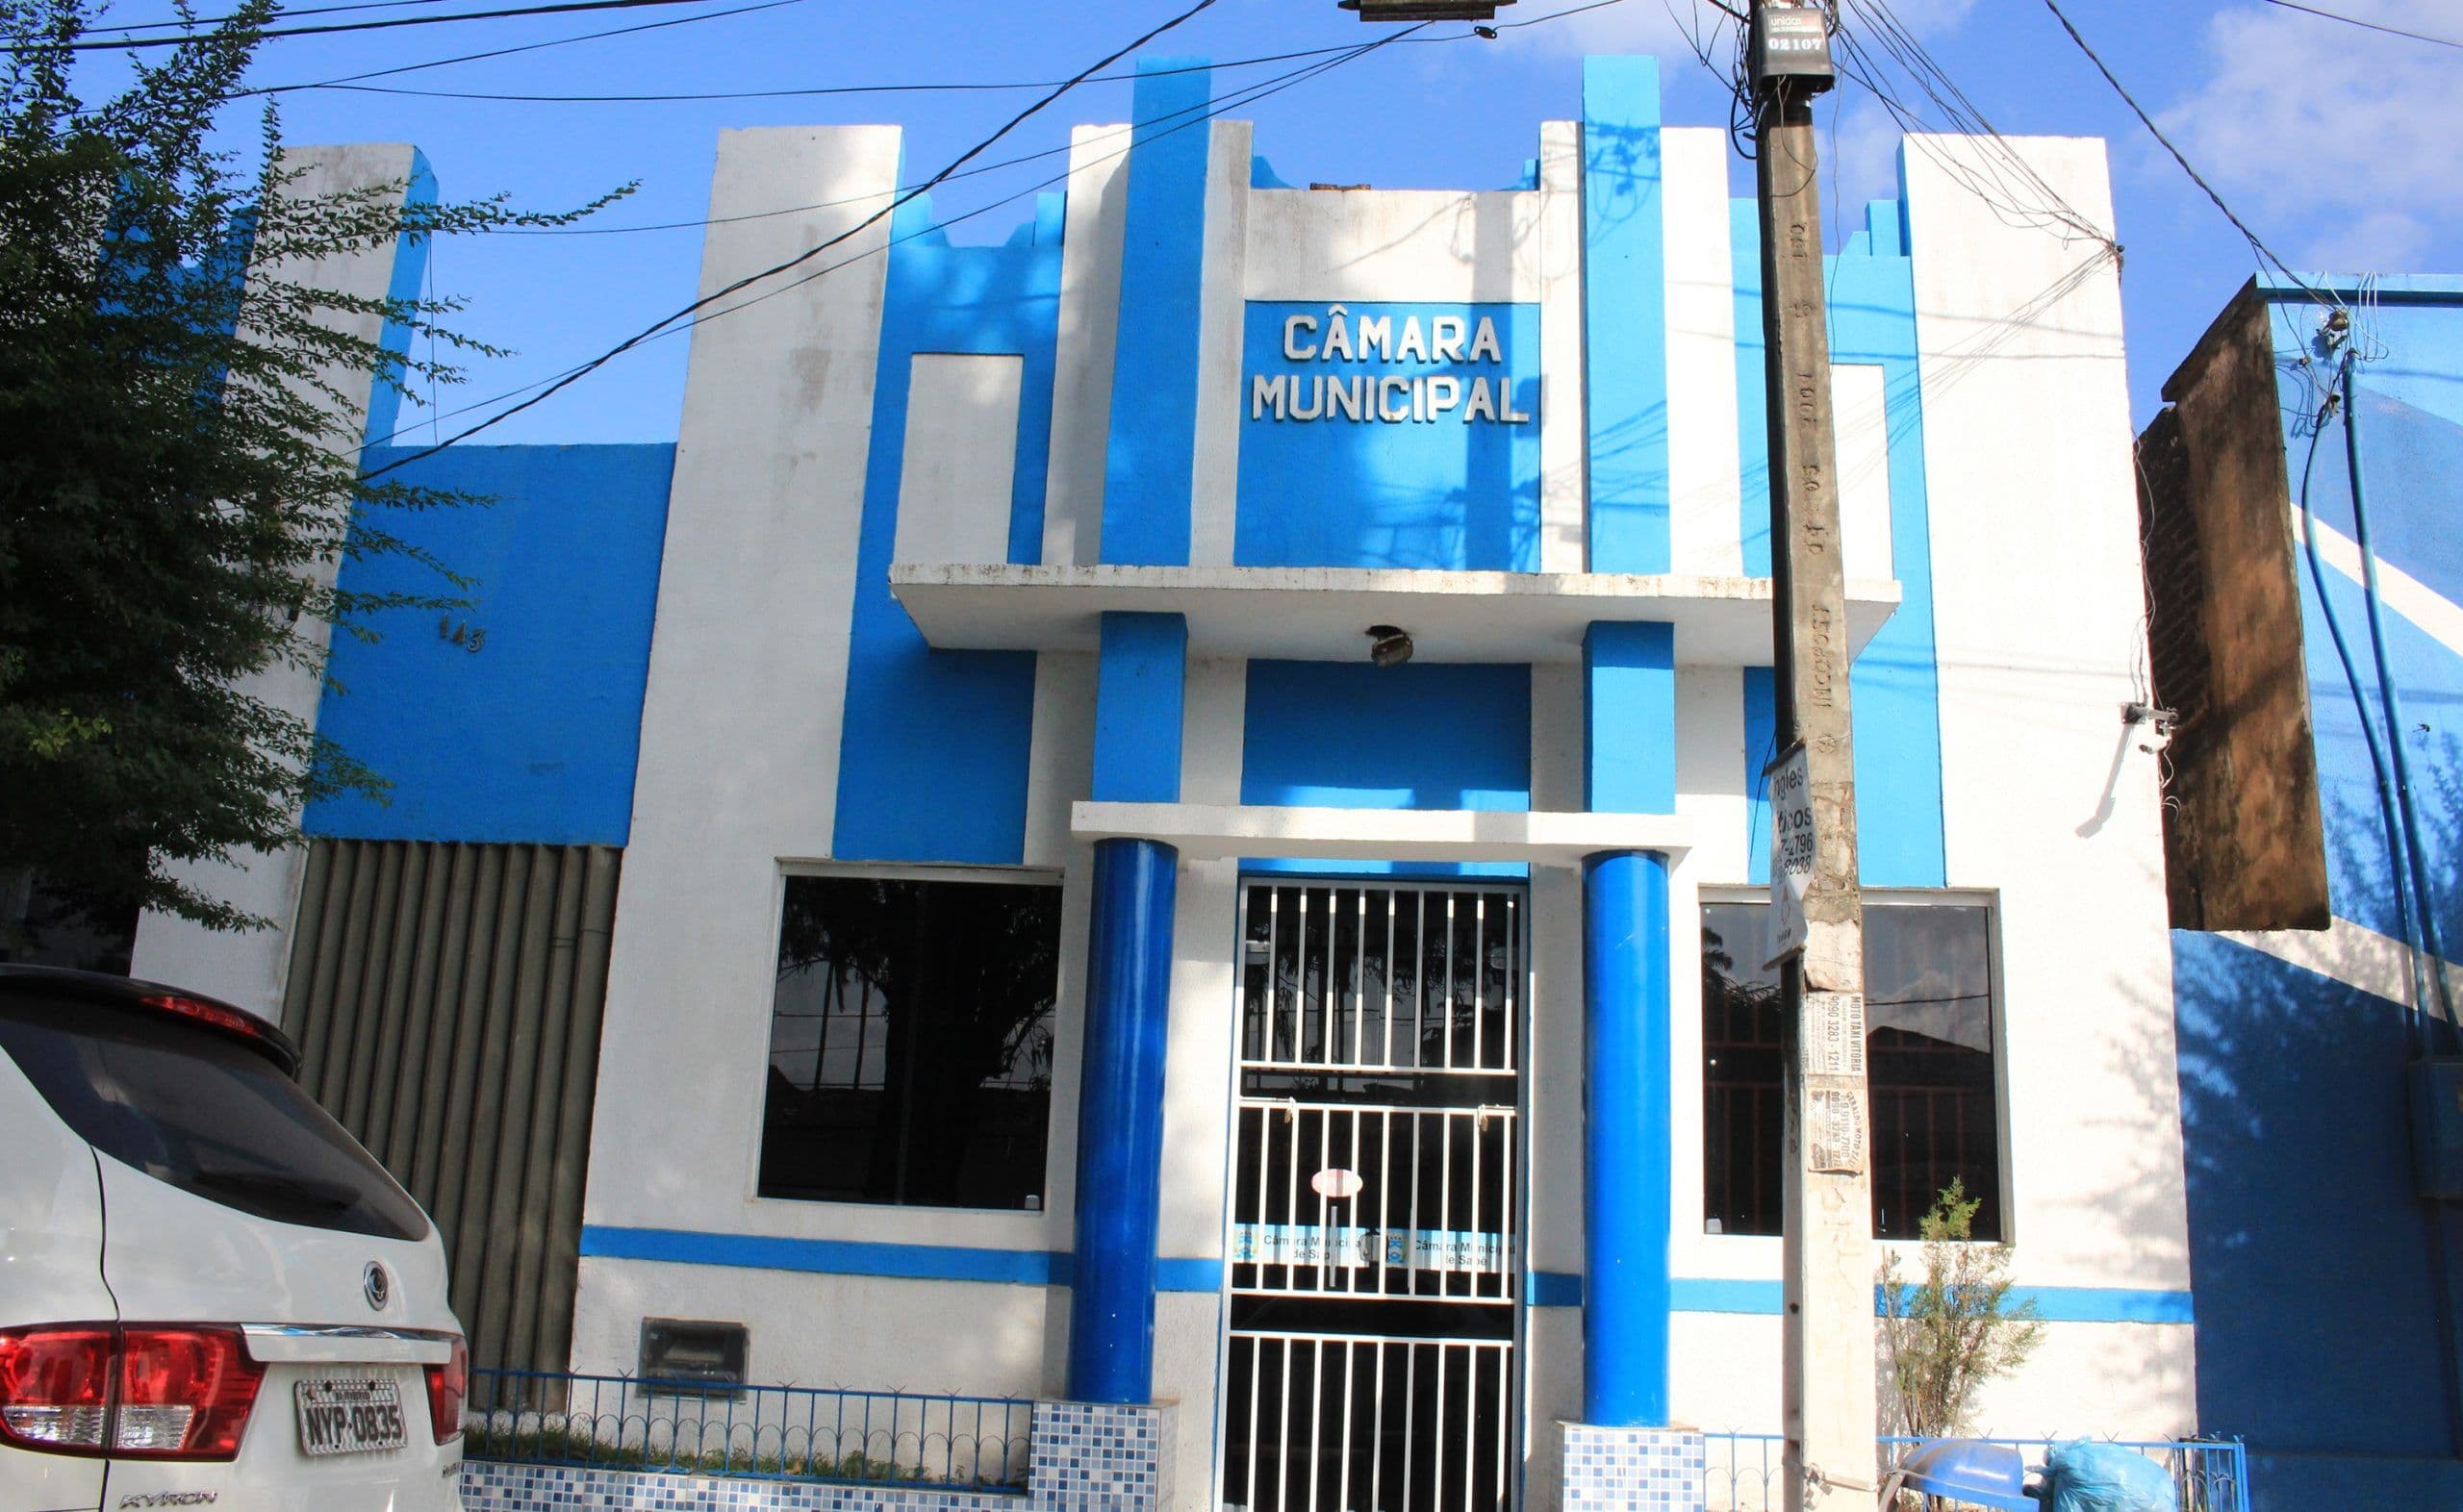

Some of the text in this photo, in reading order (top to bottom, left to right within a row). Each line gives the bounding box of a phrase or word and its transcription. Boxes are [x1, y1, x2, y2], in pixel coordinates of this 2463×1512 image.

[1768, 38, 1822, 51] 02107
[1283, 304, 1502, 365] CÂMARA
[1253, 374, 1530, 424] MUNICIPAL
[1850, 995, 1862, 1020] MOTO
[119, 1490, 218, 1509] KYRON
